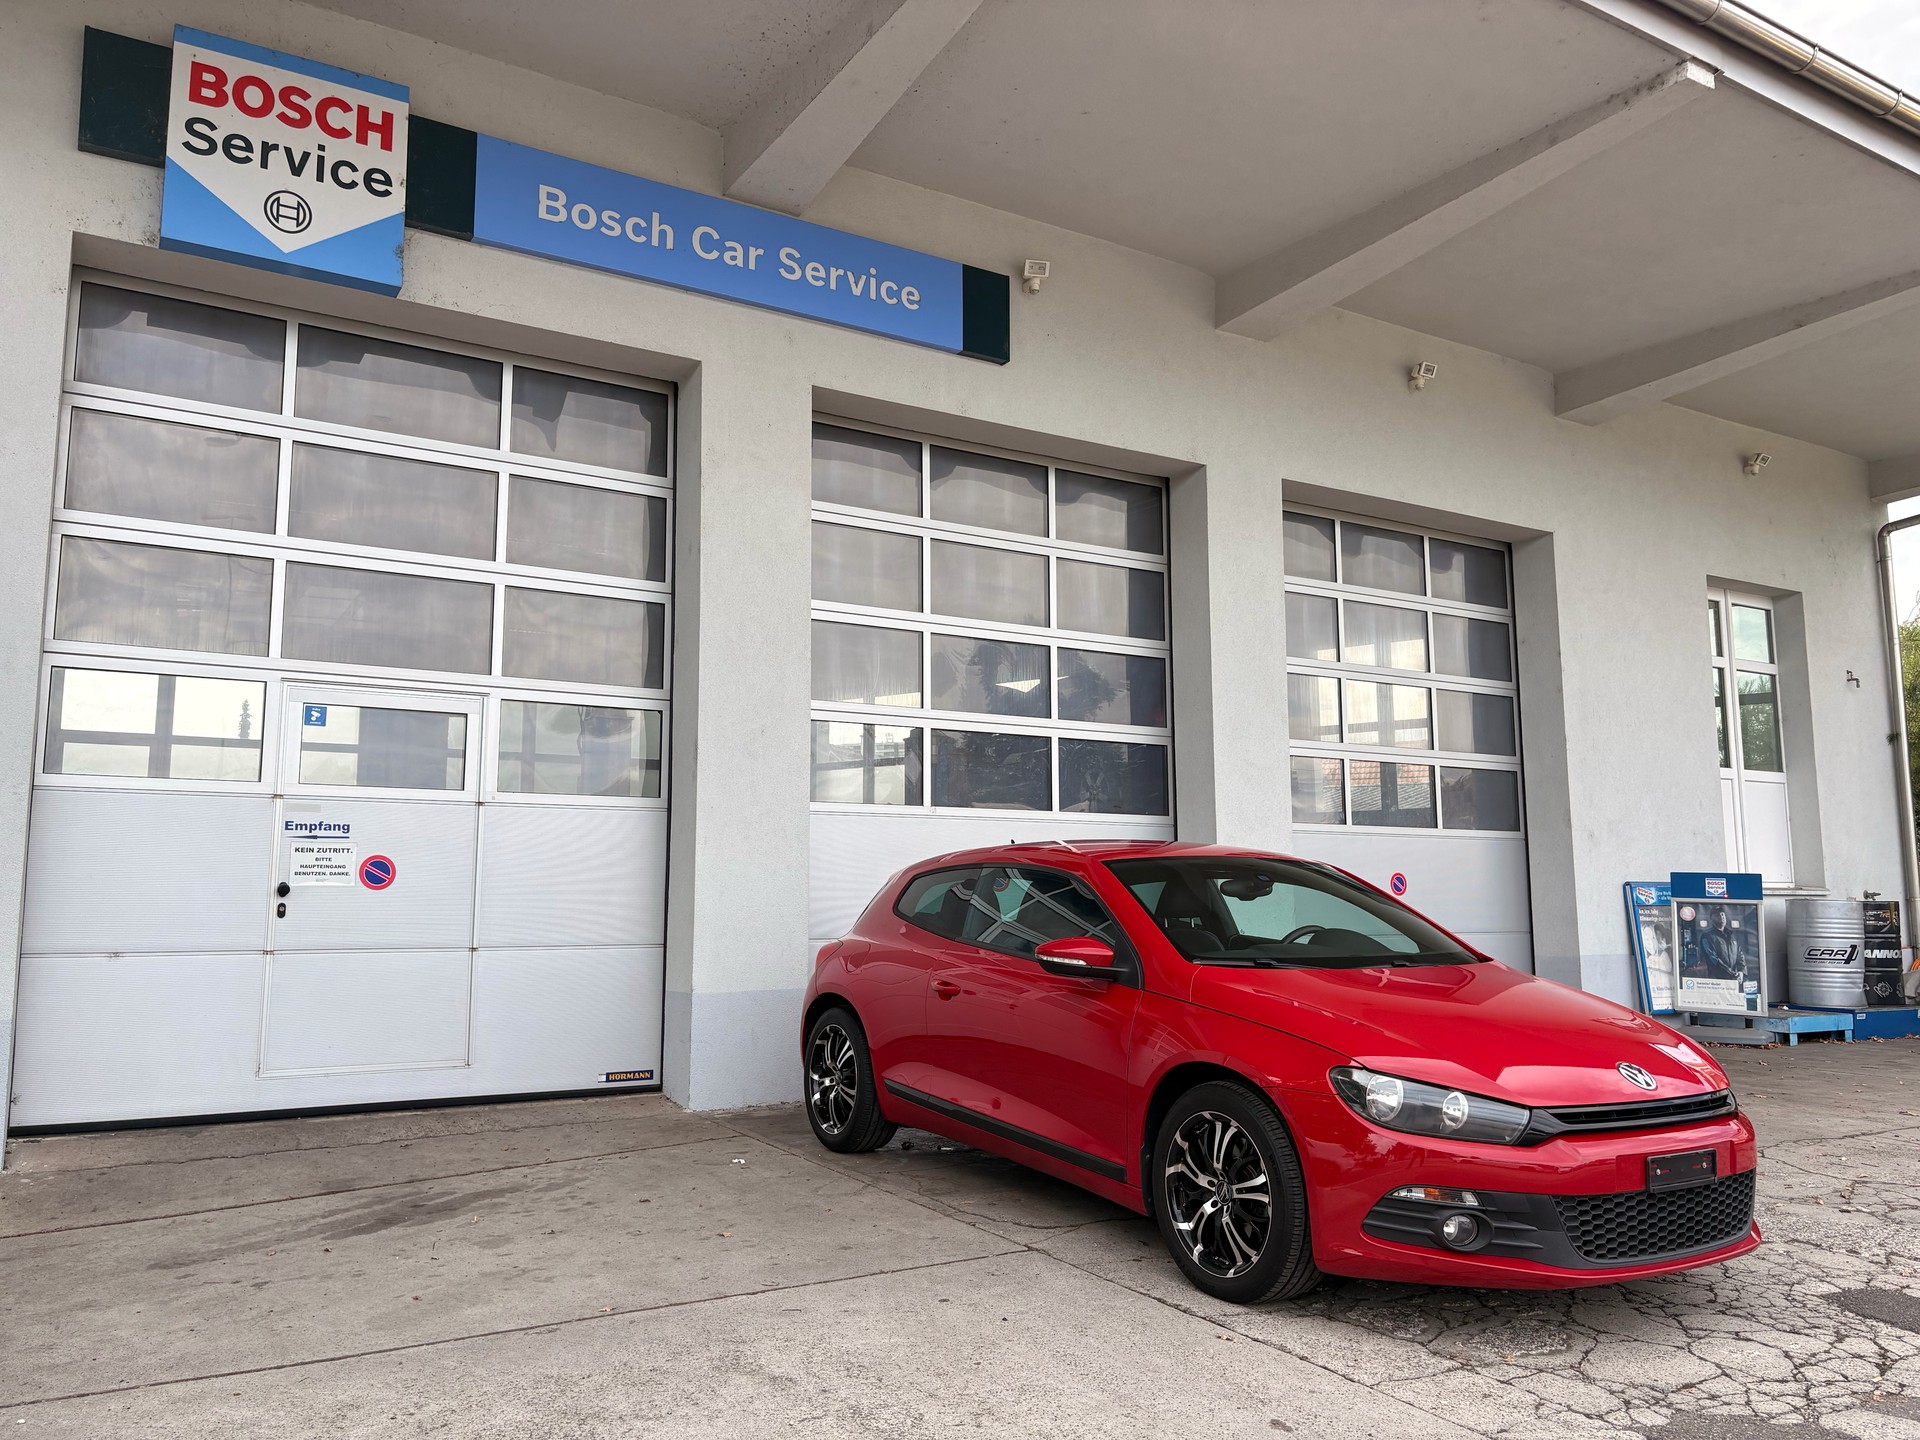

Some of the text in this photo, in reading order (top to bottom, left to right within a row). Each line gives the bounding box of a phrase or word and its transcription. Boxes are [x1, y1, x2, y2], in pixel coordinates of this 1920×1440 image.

[188, 61, 393, 152] BOSCH
[182, 117, 393, 197] Service
[538, 184, 921, 310] Bosch Car Service
[285, 820, 350, 834] Empfang
[1807, 944, 1858, 964] CAR1
[1864, 949, 1902, 959] ANNO
